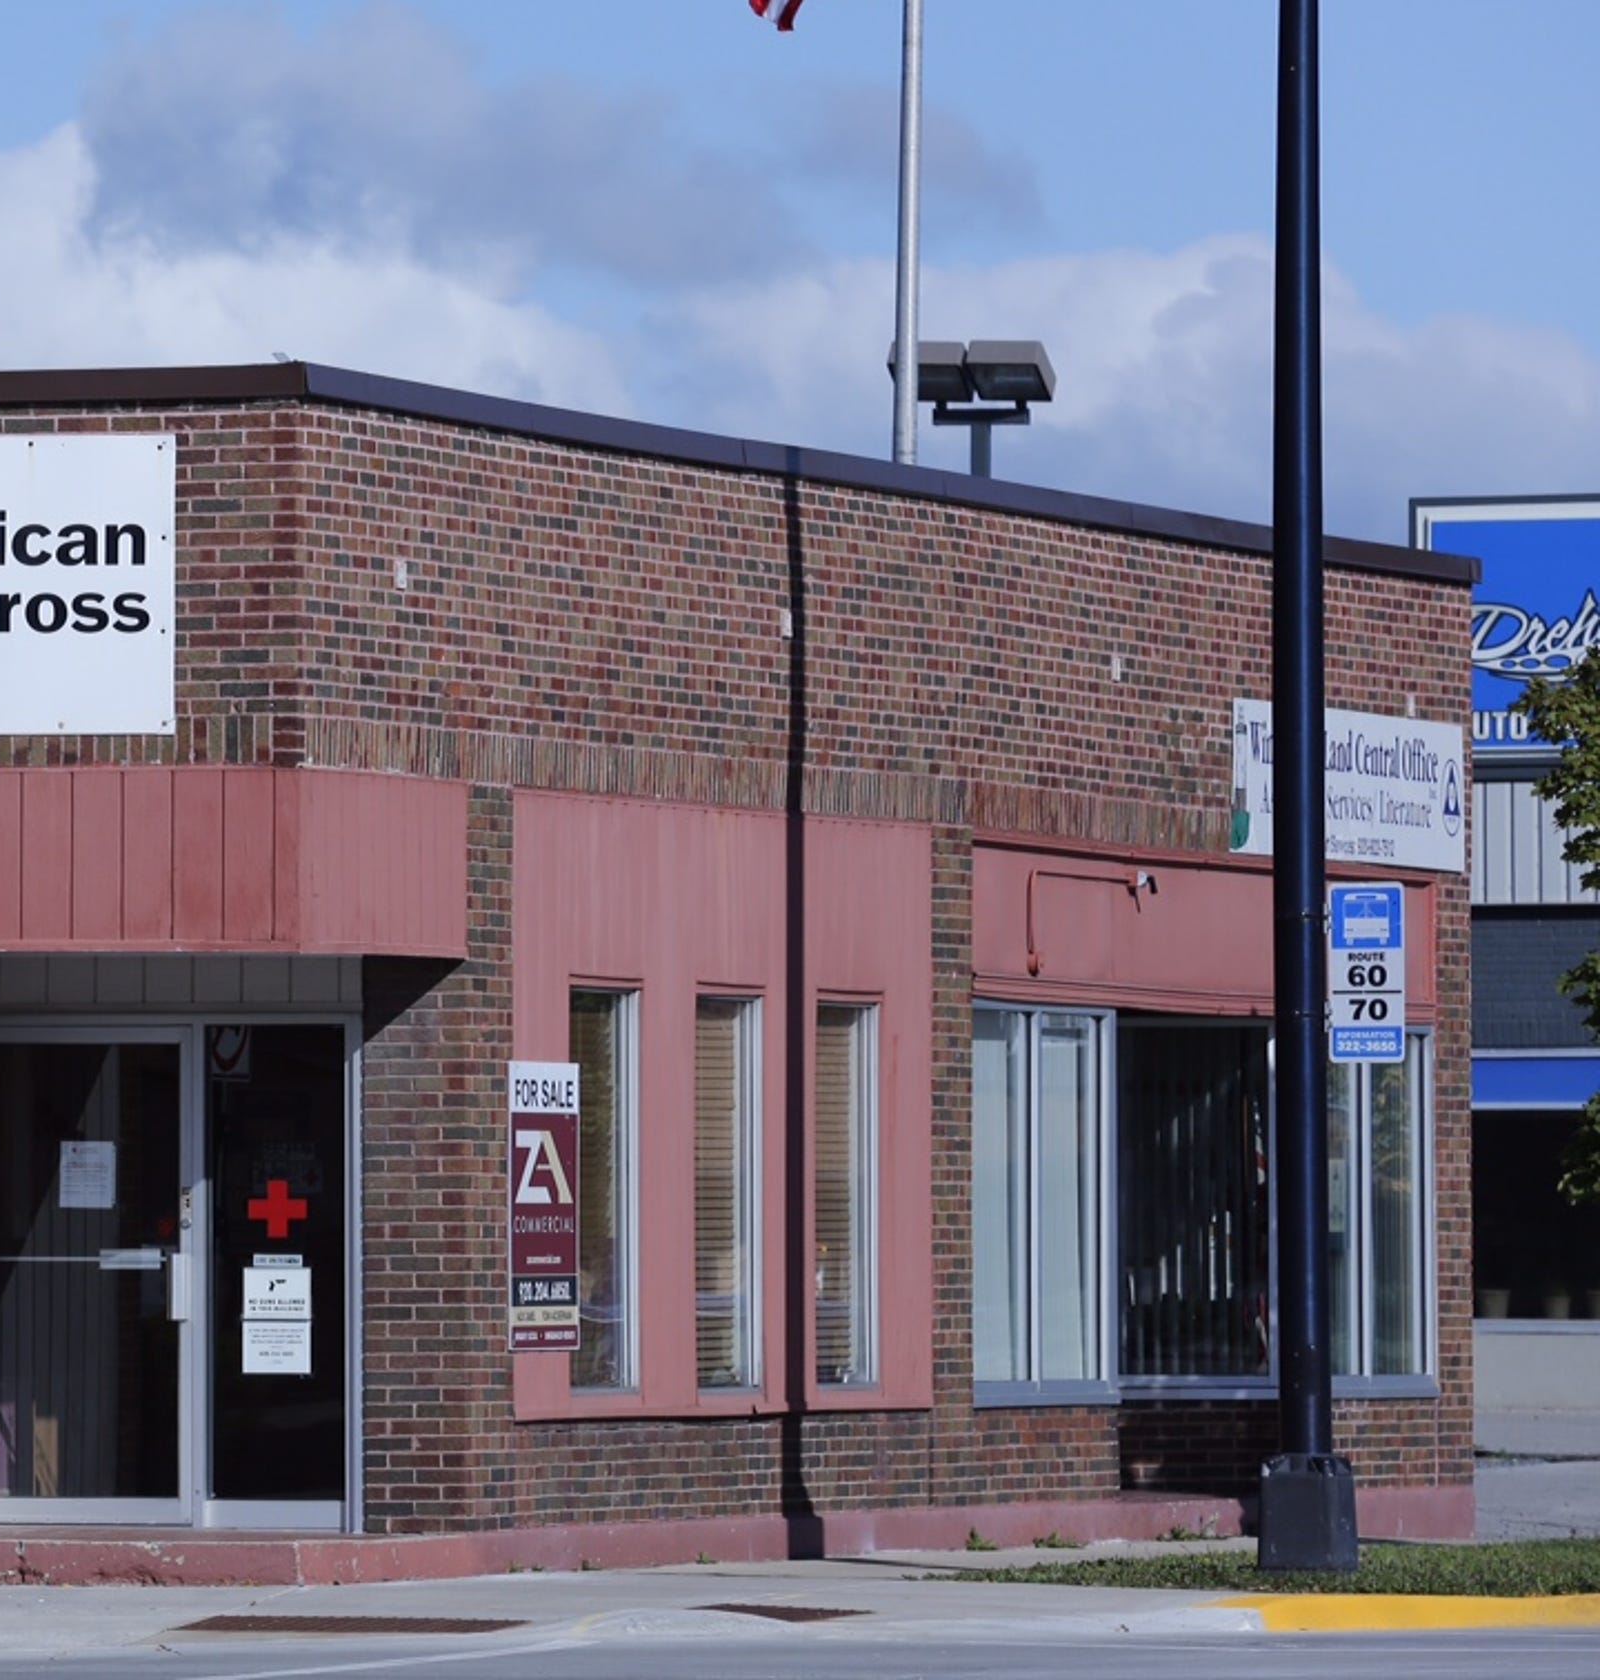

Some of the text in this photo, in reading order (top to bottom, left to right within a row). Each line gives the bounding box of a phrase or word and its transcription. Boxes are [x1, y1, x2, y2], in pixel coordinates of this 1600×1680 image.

[1471, 588, 1600, 663] Dreh
[1472, 711, 1529, 741] UTO
[1355, 733, 1400, 779] Central
[1402, 738, 1438, 783] Office
[1348, 952, 1385, 961] ROUTE
[1348, 965, 1387, 987] 60
[1348, 999, 1388, 1020] 70
[1337, 1031, 1396, 1039] INFORMATION
[514, 1079, 574, 1108] FOR SALE
[514, 1215, 575, 1233] COMMERCIAL
